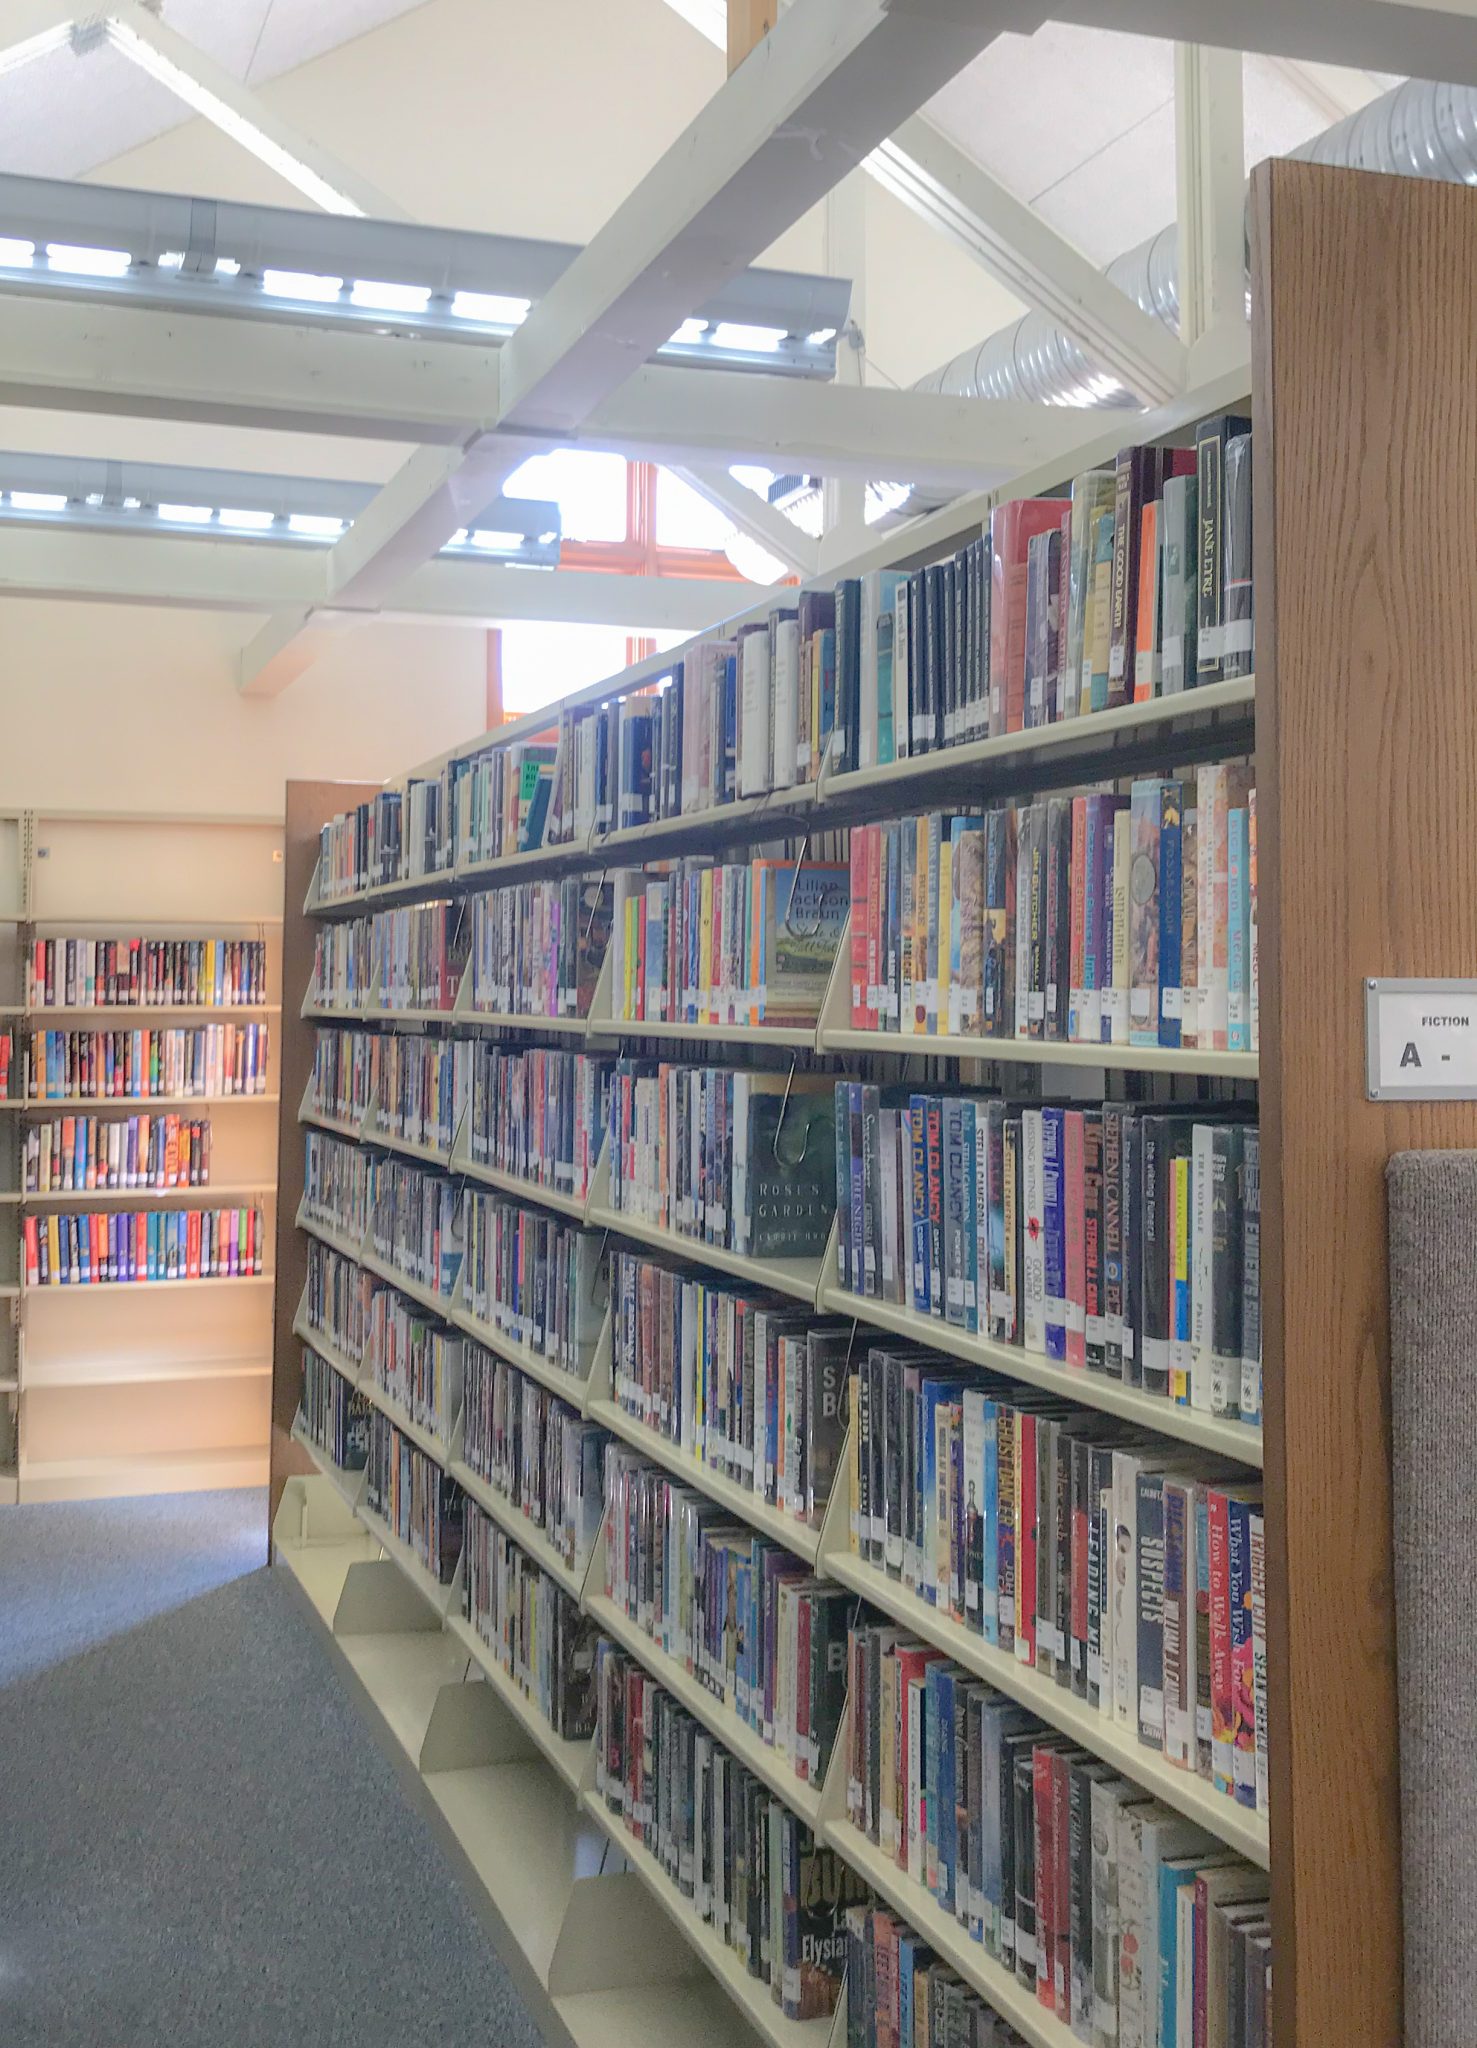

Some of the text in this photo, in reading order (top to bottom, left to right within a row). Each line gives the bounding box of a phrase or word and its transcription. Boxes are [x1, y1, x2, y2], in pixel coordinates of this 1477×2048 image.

[1202, 518, 1214, 555] JANE
[1113, 524, 1125, 628] THE GOOD EARTH
[1201, 558, 1214, 597] EYRE
[897, 605, 905, 634] Lord
[793, 894, 849, 907] ackson
[918, 874, 926, 926] BURKE
[1031, 874, 1039, 941] BUTCHER
[1166, 839, 1175, 935] POSSESSION
[795, 907, 840, 920] Braun
[1421, 1015, 1470, 1027] FICTION
[1399, 1041, 1422, 1068] A
[912, 1107, 923, 1142] TOM
[928, 1109, 939, 1147] TOM
[950, 1110, 962, 1146] TOM
[976, 1127, 984, 1169] STELLA
[1044, 1119, 1057, 1158] STEPHEN
[1106, 1112, 1119, 1176] STEPHEN
[837, 1141, 844, 1164] ME
[1027, 1116, 1036, 1211] MISSING WITNESS
[837, 1171, 844, 1197] GO
[913, 1147, 923, 1218] CLANCY
[929, 1152, 940, 1223] CLANCY
[950, 1152, 962, 1224] CLANCY
[976, 1172, 984, 1227] CAMERON
[1044, 1170, 1059, 1208] CANNELL
[1145, 1141, 1156, 1241] the viking funeral
[853, 1173, 862, 1253] THE NIGHT
[1106, 1184, 1119, 1252] CANNELL
[1086, 1218, 1097, 1267] STEPHEN
[1195, 1152, 1205, 1342] THE VOYAGE Philip
[1244, 1222, 1259, 1296] ENDER'S
[1033, 1259, 1042, 1302] GORDO
[1087, 1269, 1097, 1280] J.
[998, 1416, 1014, 1527] GHOST DANCER
[1055, 1457, 1066, 1499] wiley
[1056, 1505, 1067, 1542] cash
[1004, 1560, 1014, 1596] JOH
[1088, 1525, 1100, 1617] LEADING
[1140, 1535, 1163, 1625] SUSPECTS
[1164, 1599, 1179, 1655] WILLIAM
[1211, 1524, 1227, 1694] How to Walk Away
[1230, 1518, 1244, 1689] What You Wish For
[1254, 1652, 1266, 1693] SEAN
